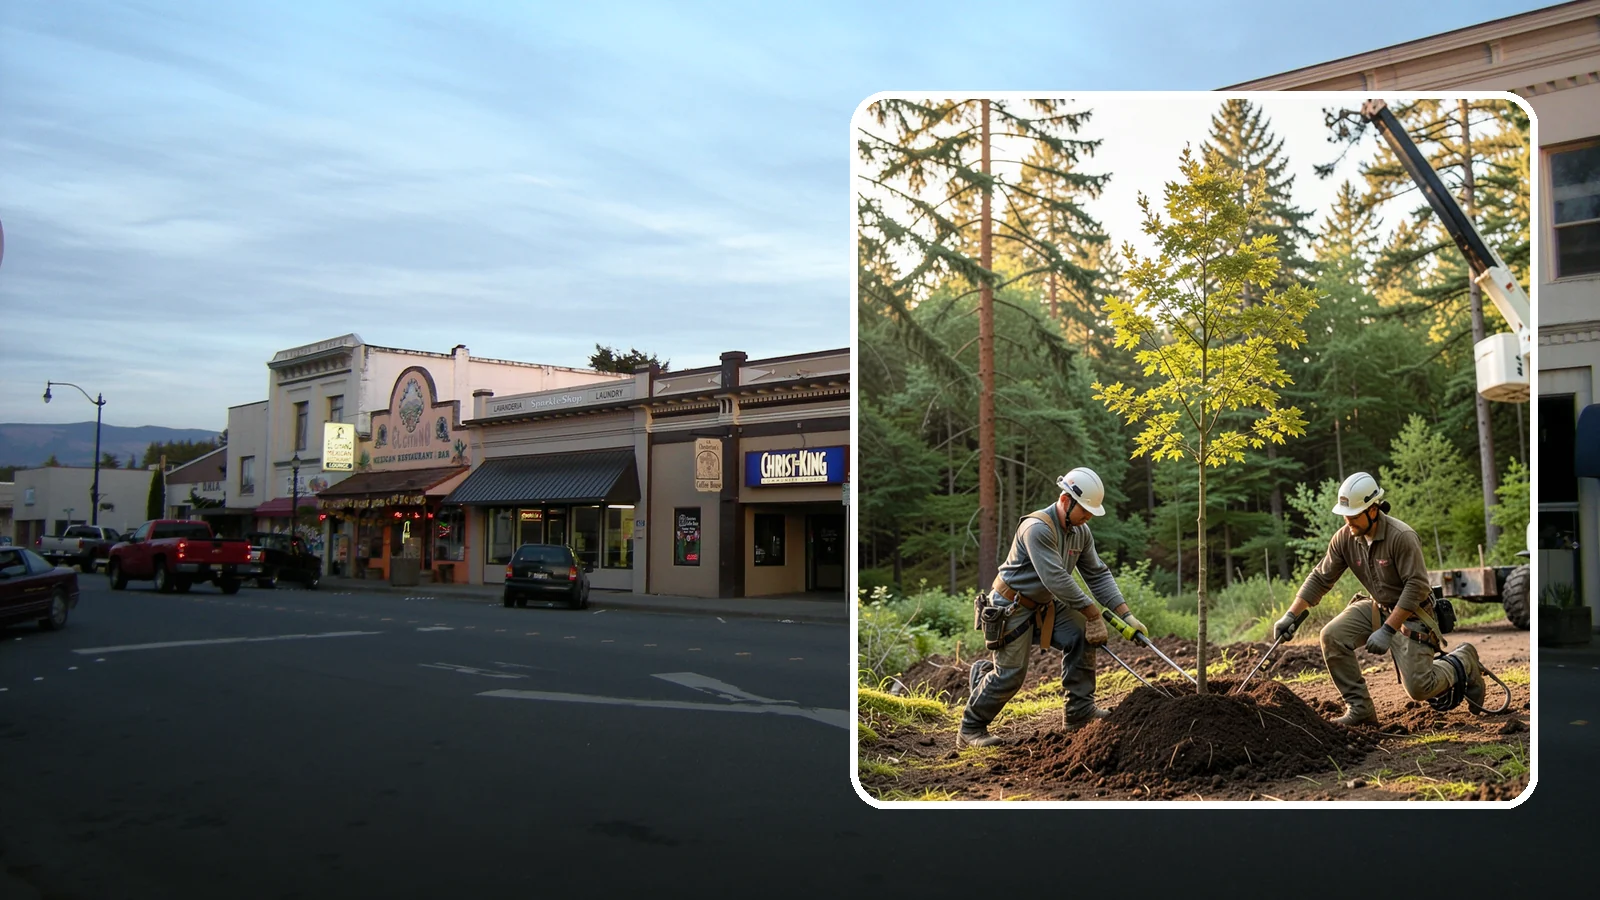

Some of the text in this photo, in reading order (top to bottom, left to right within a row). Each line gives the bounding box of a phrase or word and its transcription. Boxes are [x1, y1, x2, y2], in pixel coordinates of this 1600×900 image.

[531, 394, 582, 408] Sparkle Shop
[595, 389, 623, 400] LAUNDRY
[493, 402, 522, 413] LAVANDERIA
[373, 450, 450, 464] MEXICAN RESTAURANT BAR
[761, 450, 827, 478] CHRIST KING
